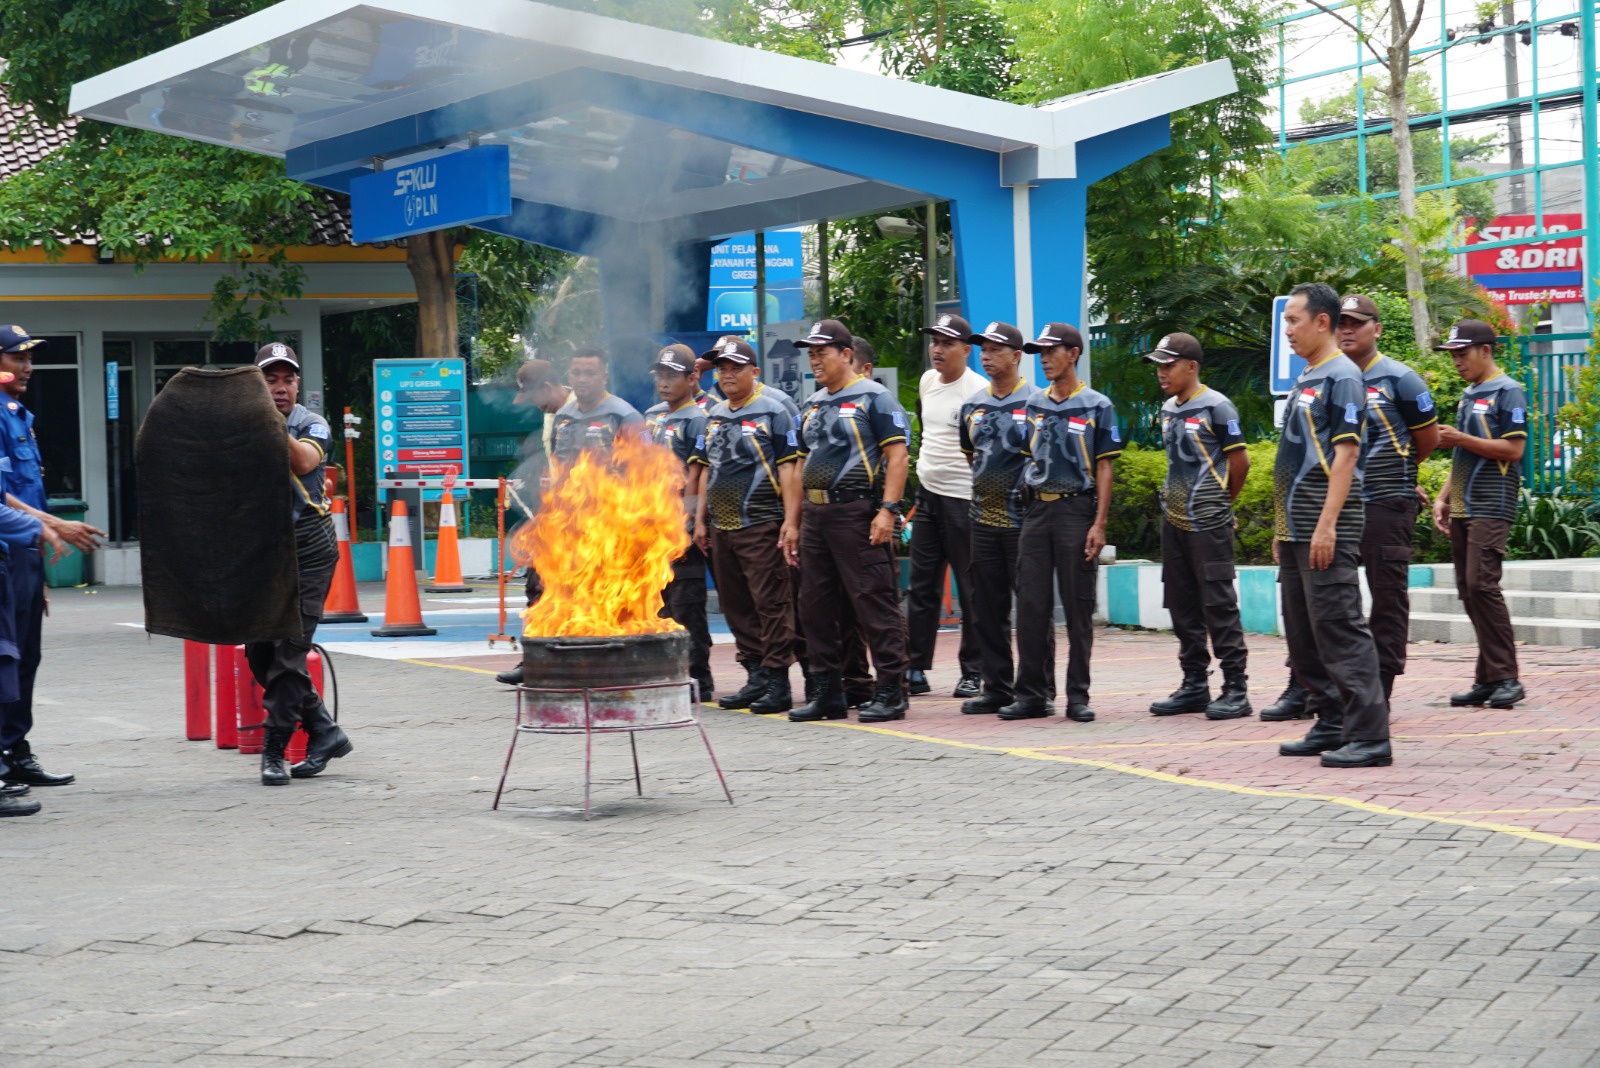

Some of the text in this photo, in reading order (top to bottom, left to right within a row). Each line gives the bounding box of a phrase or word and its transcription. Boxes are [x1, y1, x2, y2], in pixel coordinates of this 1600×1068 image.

[393, 163, 437, 196] SPKLU
[415, 194, 438, 218] PLN
[746, 258, 794, 268] PENGGAN
[1496, 247, 1583, 270] &DRI
[731, 270, 758, 280] GRESI
[1550, 289, 1576, 300] Parts
[720, 313, 752, 327] PLN
